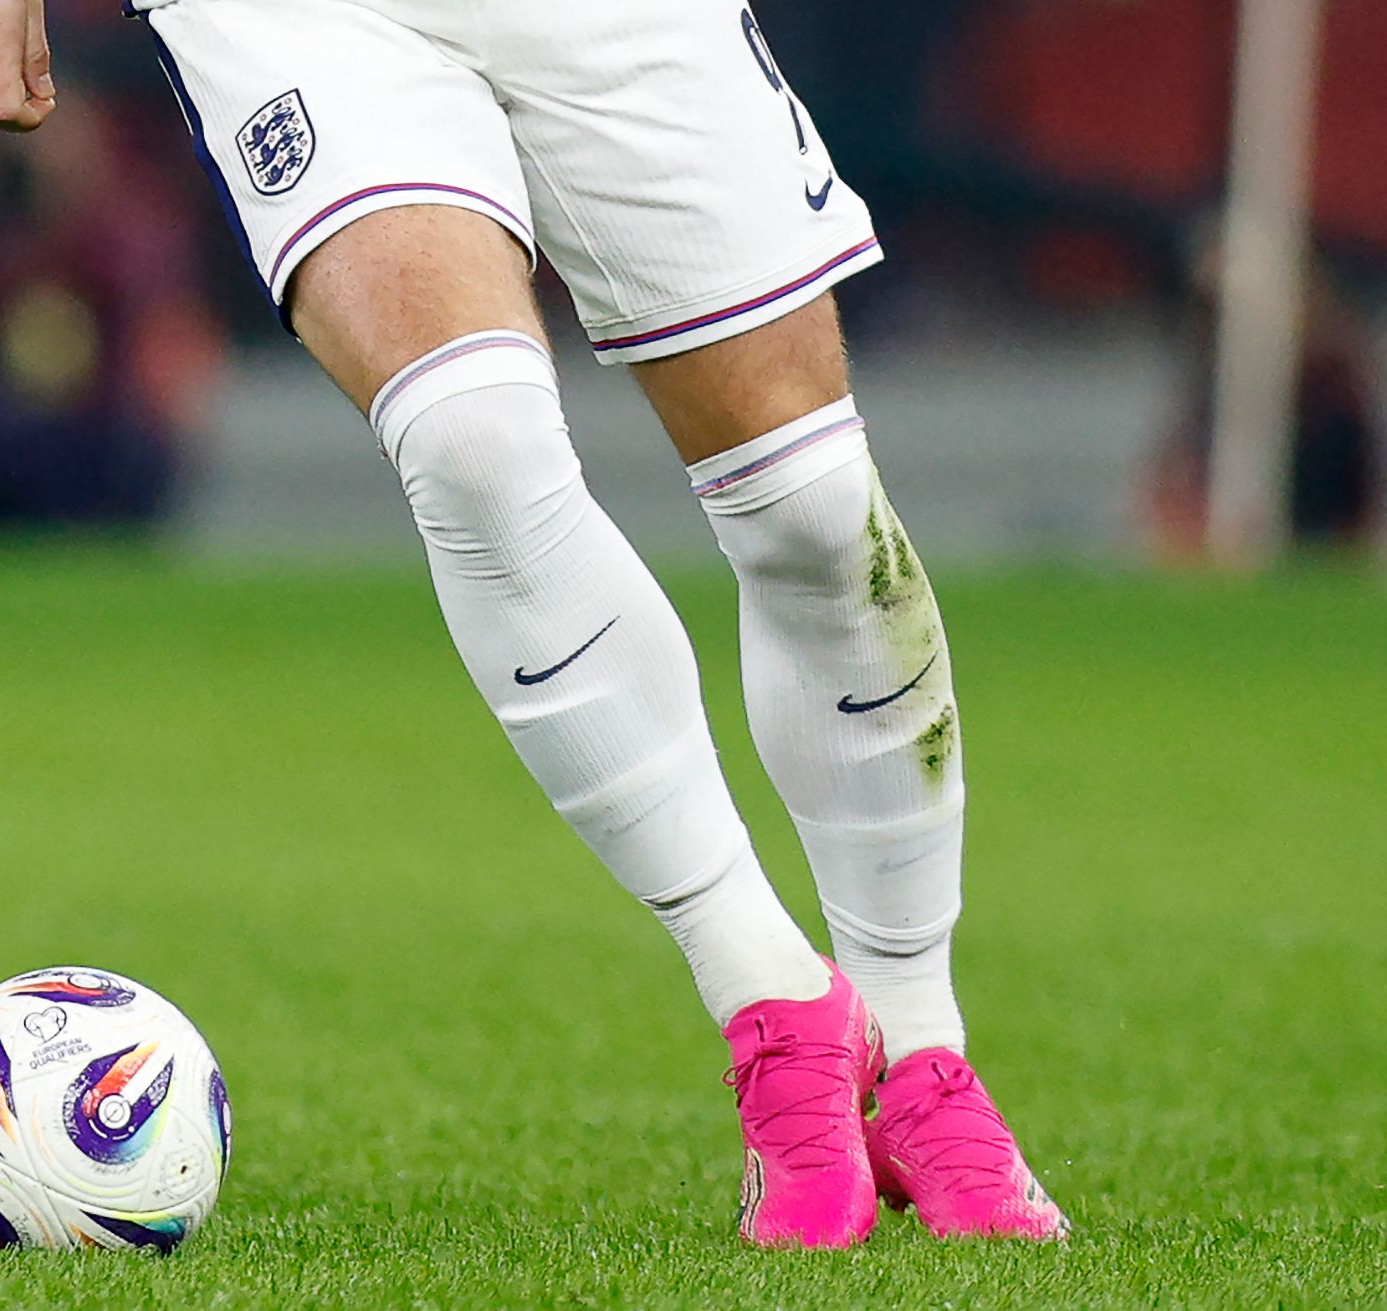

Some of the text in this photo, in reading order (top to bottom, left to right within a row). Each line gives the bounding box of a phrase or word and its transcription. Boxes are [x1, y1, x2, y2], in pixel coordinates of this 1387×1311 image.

[740, 7, 808, 156] 9
[29, 1043, 92, 1070] QUALIFIERS
[32, 1037, 82, 1058] EUROPEAN
